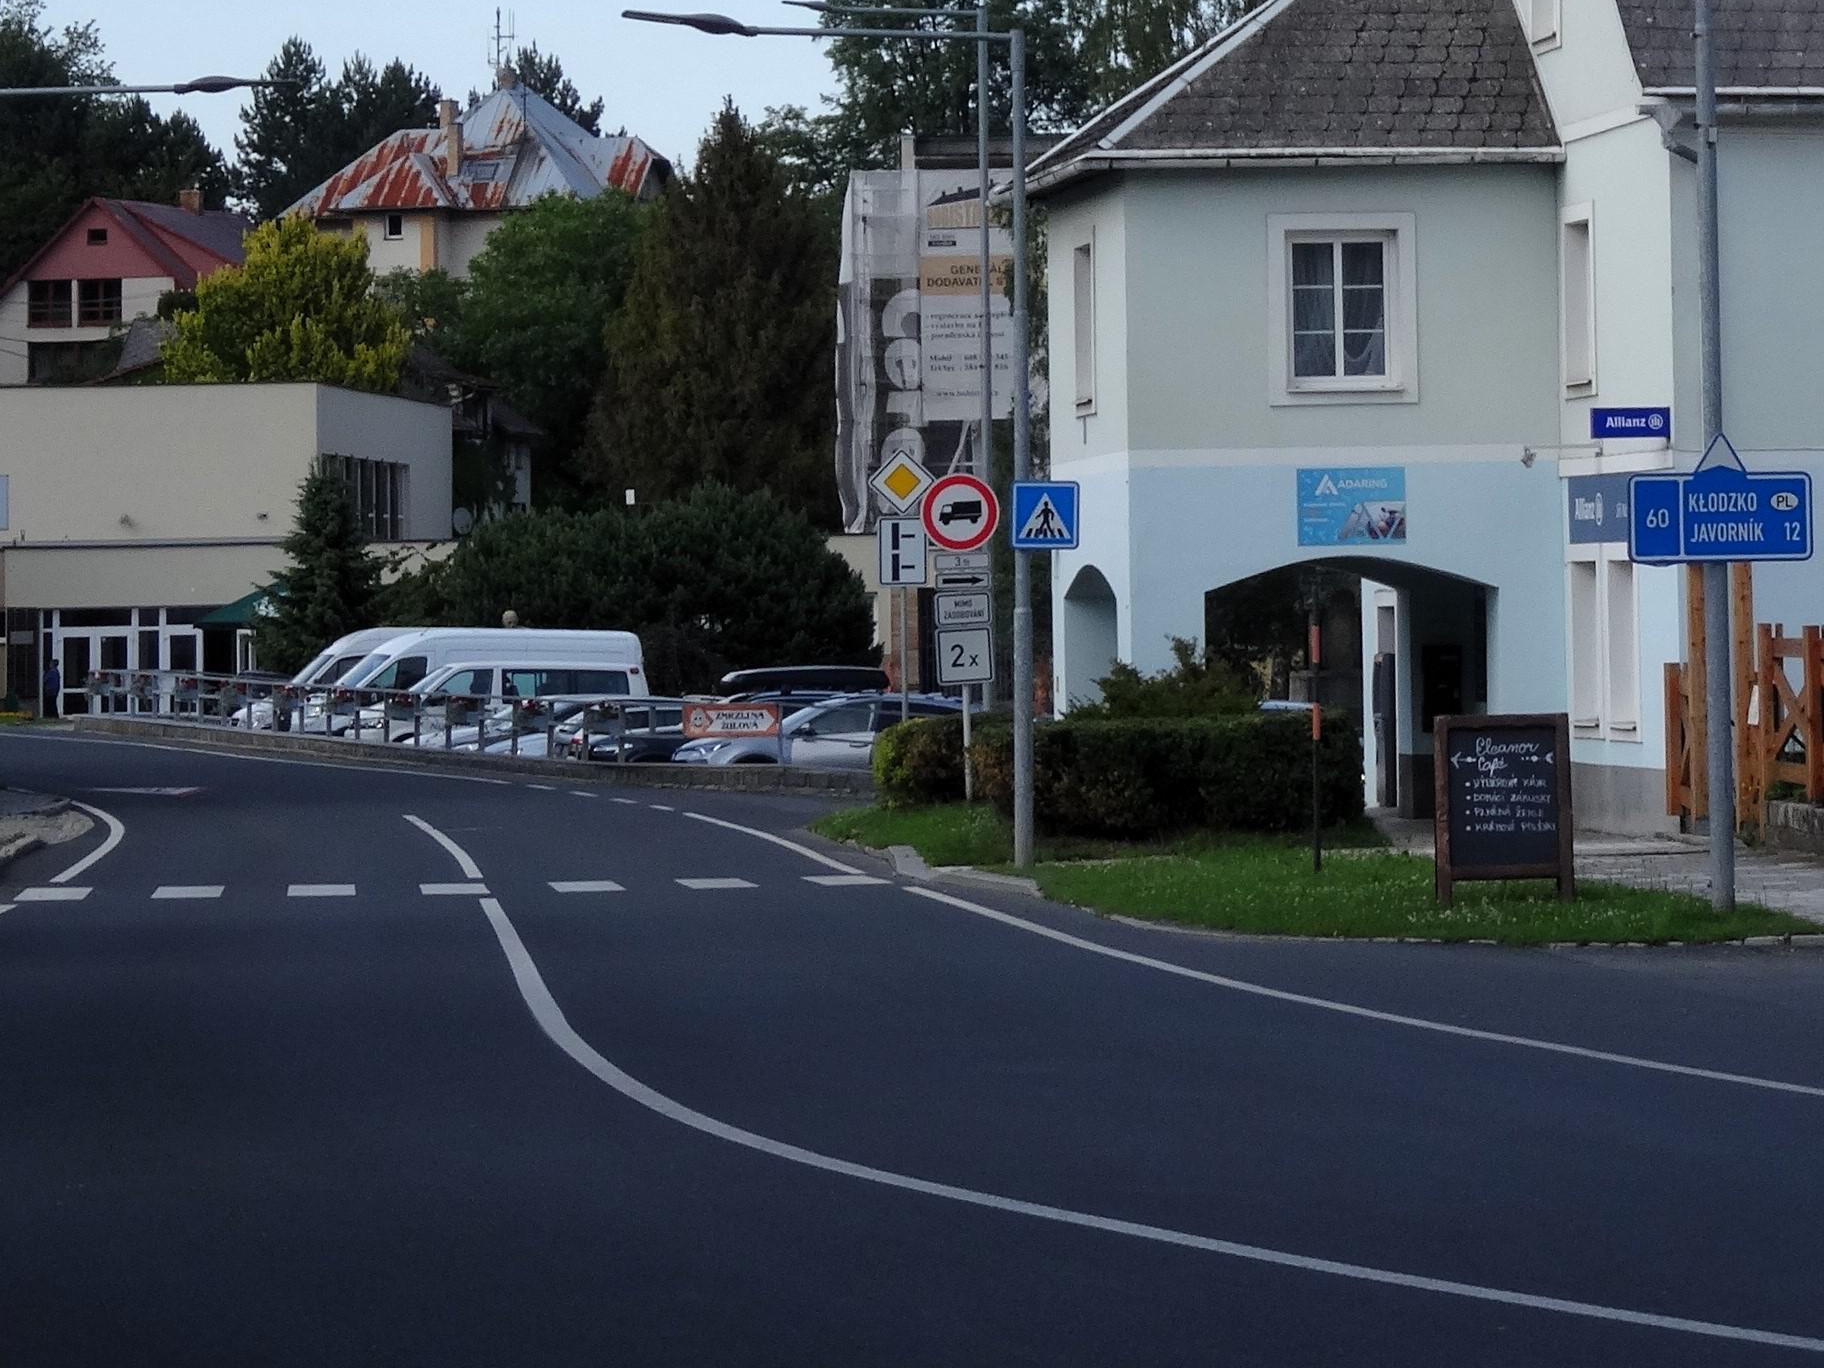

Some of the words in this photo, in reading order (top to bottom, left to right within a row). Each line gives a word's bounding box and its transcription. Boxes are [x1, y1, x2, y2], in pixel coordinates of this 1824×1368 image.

[1606, 416, 1646, 429] Allianz
[1688, 492, 1757, 513] KŁODZKO
[1776, 495, 1792, 508] PL
[1646, 509, 1669, 528] 60
[1690, 518, 1764, 543] JAVORNÍK
[1784, 522, 1800, 541] 12
